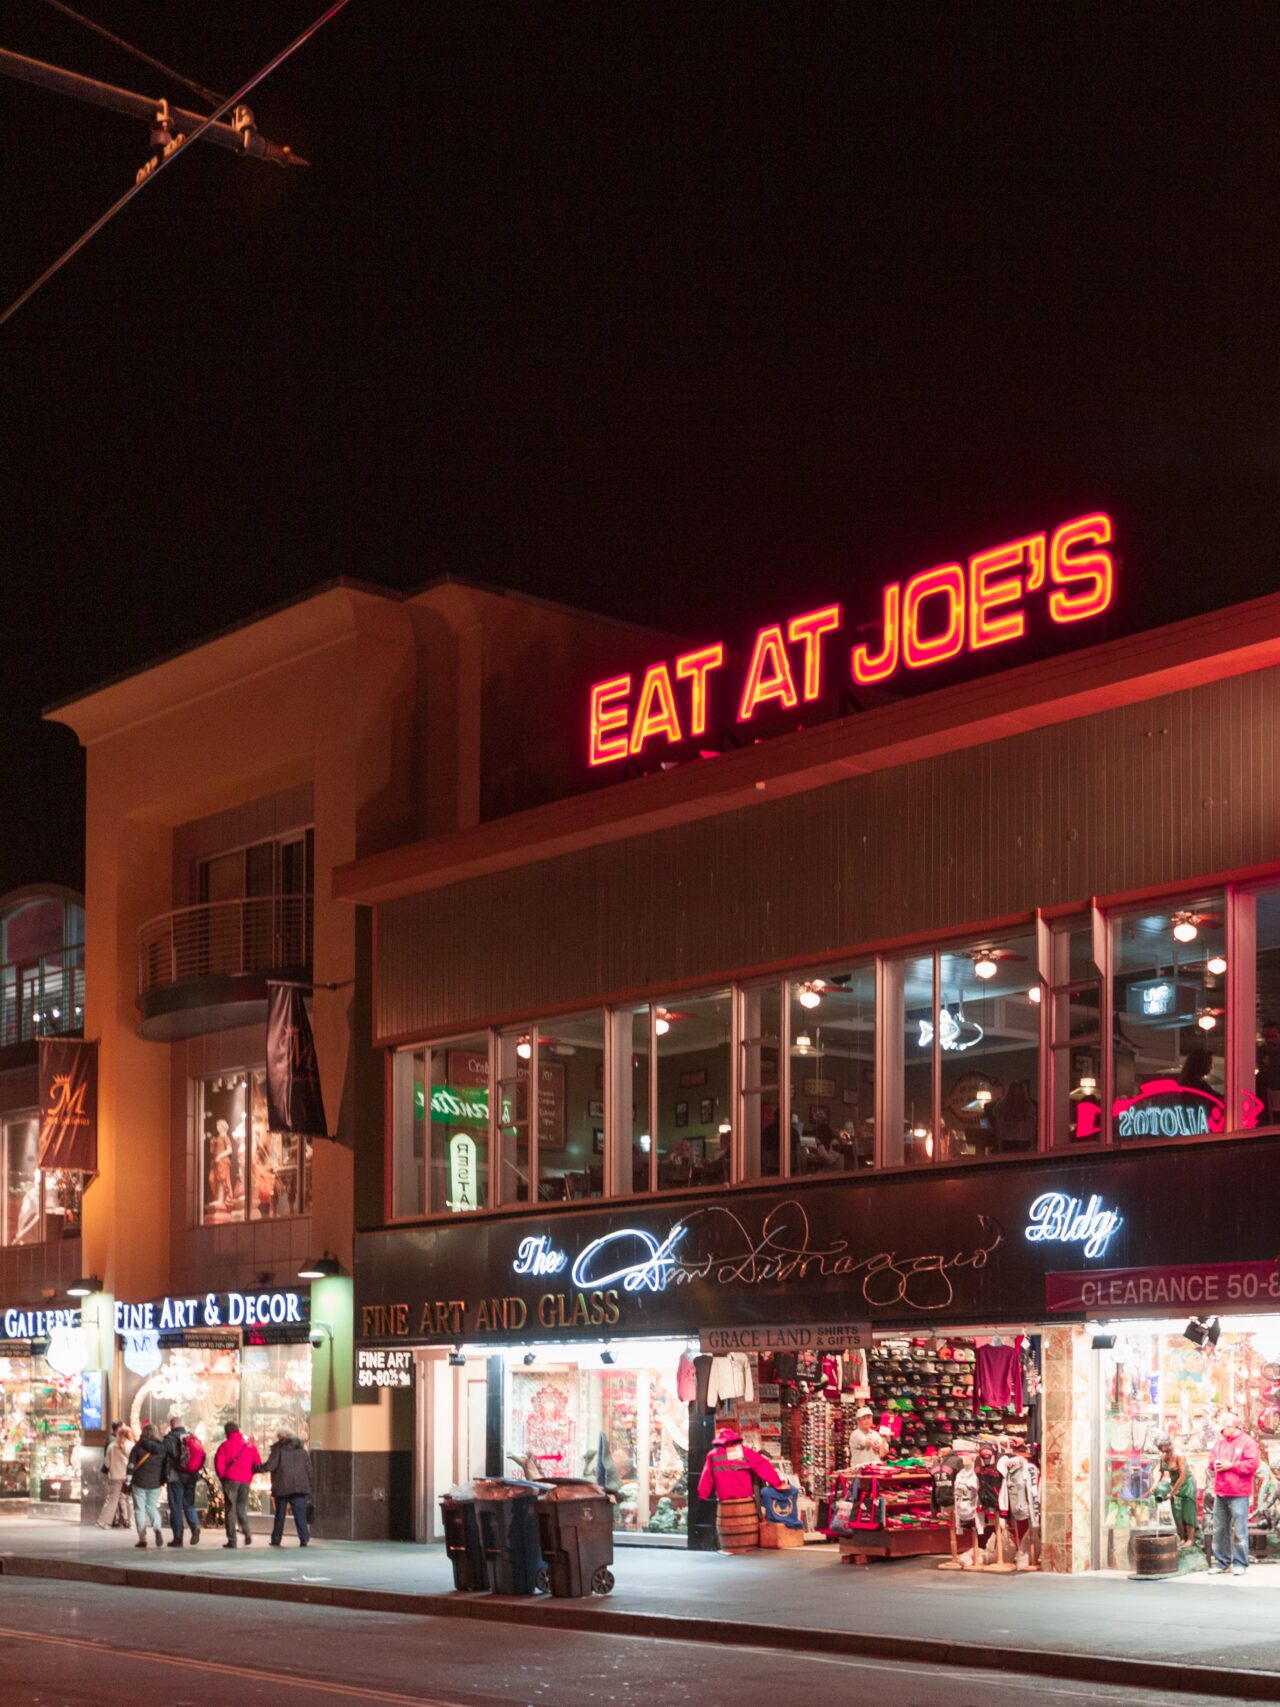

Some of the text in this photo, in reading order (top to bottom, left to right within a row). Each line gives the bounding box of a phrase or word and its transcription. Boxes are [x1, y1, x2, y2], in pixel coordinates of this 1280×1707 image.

[588, 510, 1115, 768] EAT AT JOE'S
[1024, 1192, 1120, 1258] Bldg
[513, 1235, 566, 1276] The
[1081, 1275, 1219, 1306] CLEARANCE
[4, 1308, 76, 1338] GALLERY
[114, 1293, 302, 1332] FINE ART & DECOR
[362, 1289, 621, 1337] FINE ART AND GLASS
[708, 1327, 812, 1349] GRACE LAND
[816, 1335, 862, 1346] & GIFTS
[818, 1326, 859, 1336] SHIRTS
[358, 1351, 411, 1369] FINE ART
